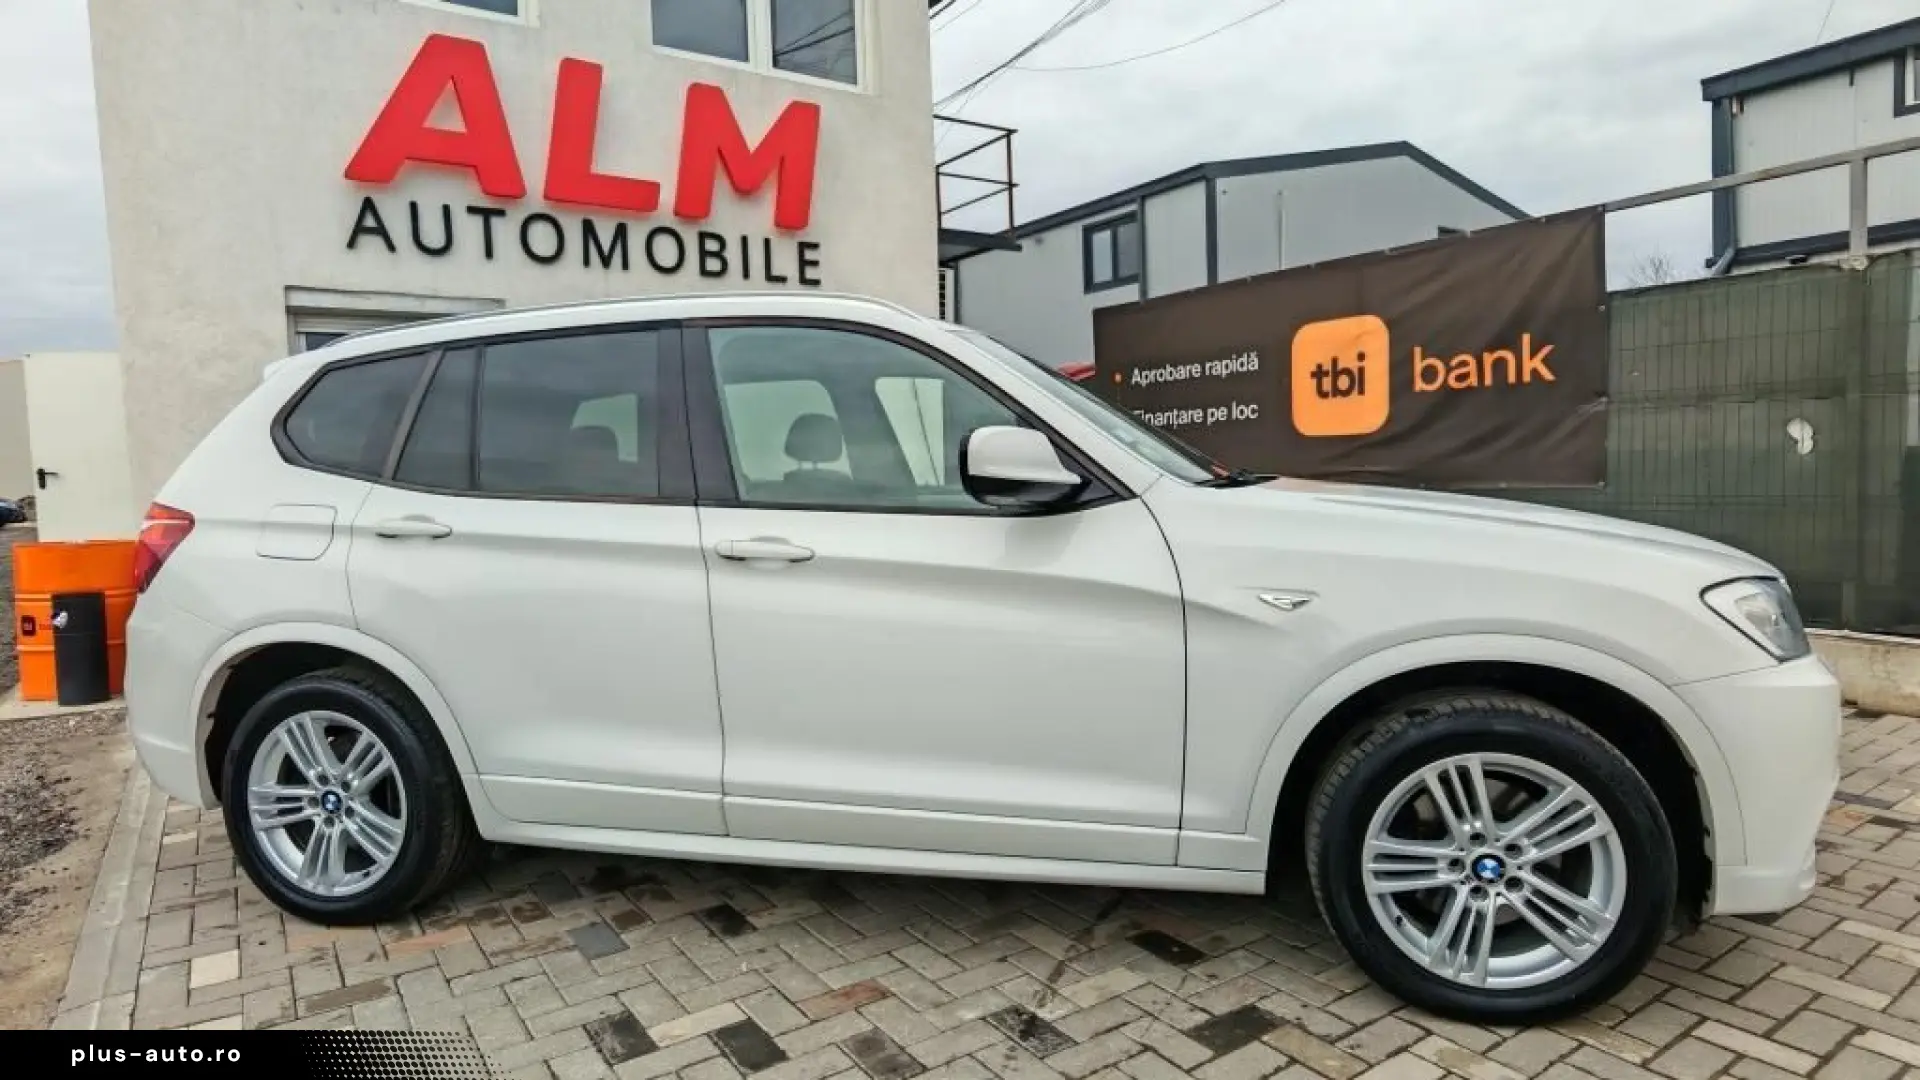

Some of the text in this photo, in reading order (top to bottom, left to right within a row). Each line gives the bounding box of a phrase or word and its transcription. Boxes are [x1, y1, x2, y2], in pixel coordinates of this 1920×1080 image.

[344, 33, 821, 231] ALM
[346, 196, 821, 285] AUTOMOBILE
[1131, 350, 1259, 387] Aprobare rapidă
[1310, 333, 1556, 400] tbi bank
[1207, 406, 1228, 426] pe
[1232, 400, 1259, 420] loc
